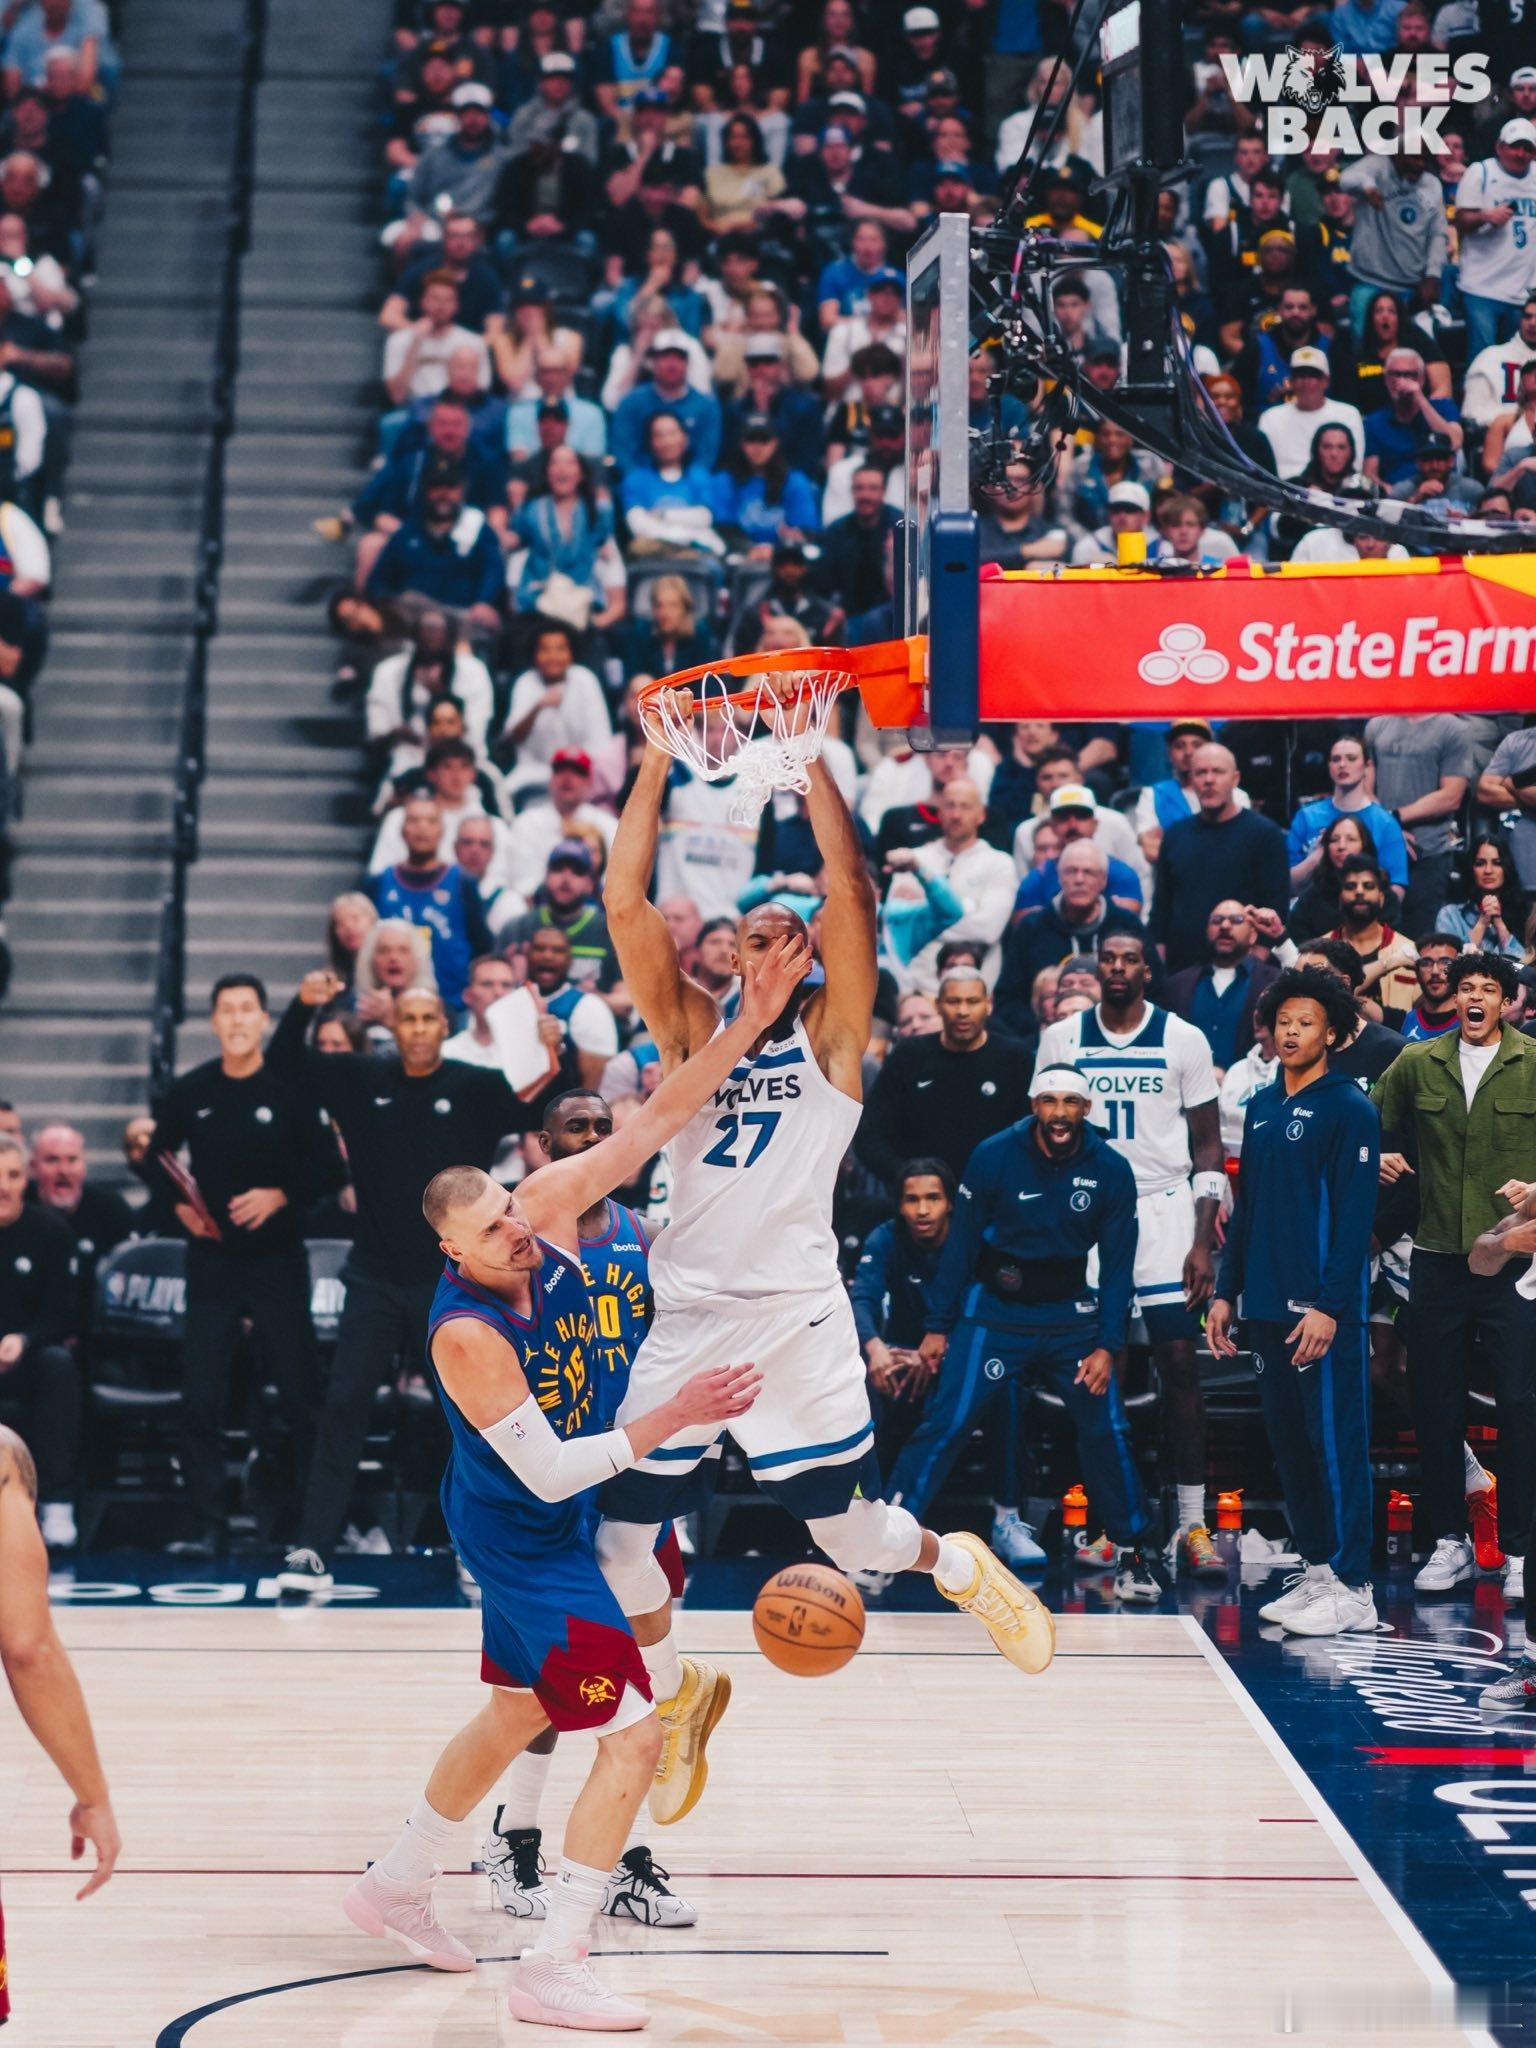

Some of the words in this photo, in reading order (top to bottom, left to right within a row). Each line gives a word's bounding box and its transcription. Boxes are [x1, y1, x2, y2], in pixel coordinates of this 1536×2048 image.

[1513, 221, 1527, 249] 5
[1104, 1100, 1135, 1140] 11
[702, 1111, 782, 1168] 27
[612, 1243, 642, 1252] ibotta
[544, 1264, 566, 1294] ibotta
[605, 1262, 645, 1318] HIGH
[537, 1341, 561, 1411] MILE
[564, 1344, 586, 1403] 15
[1073, 1530, 1088, 1549] G
[776, 1573, 847, 1608] Wilson
